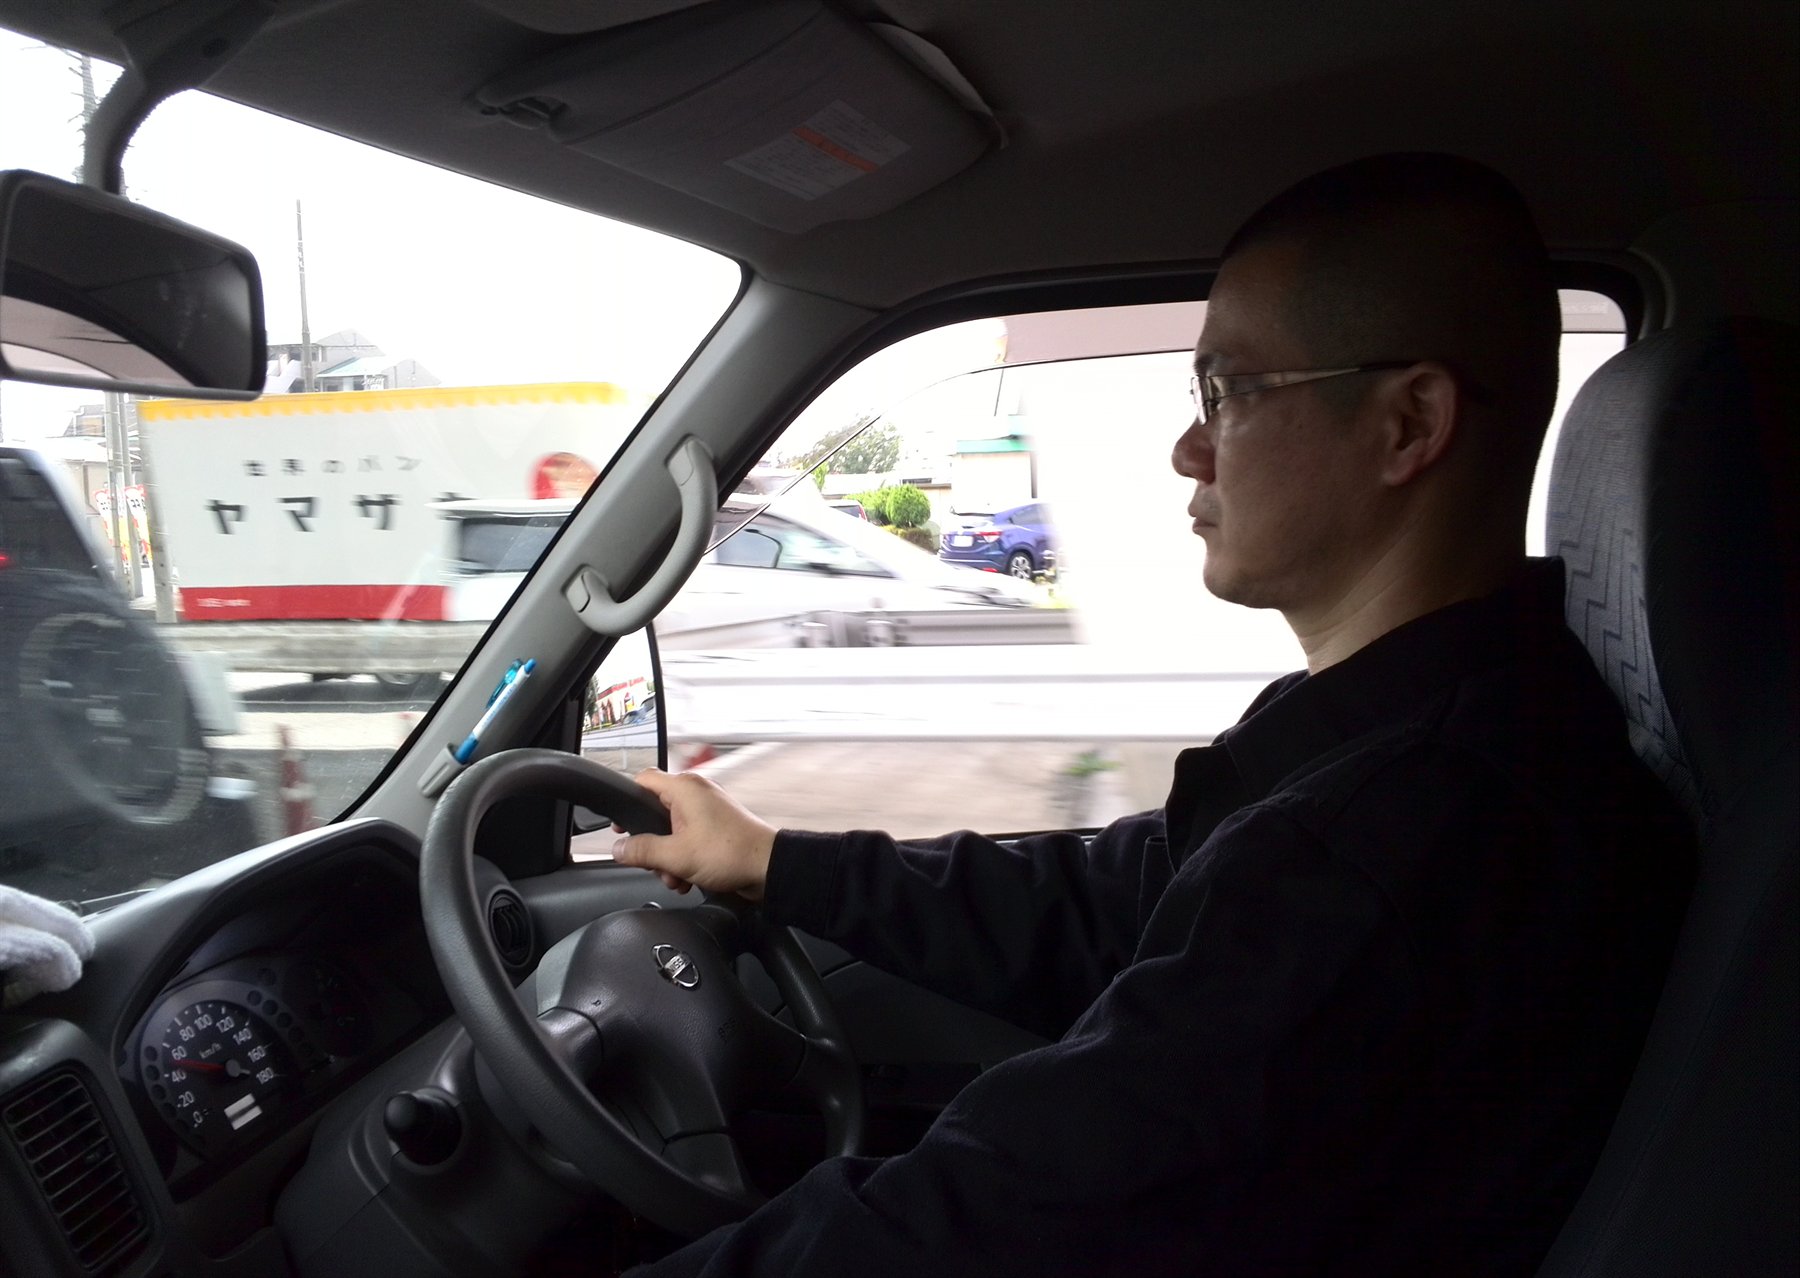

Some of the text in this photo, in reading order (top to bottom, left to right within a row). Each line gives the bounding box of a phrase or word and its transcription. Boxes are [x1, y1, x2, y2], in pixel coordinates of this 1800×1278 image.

[194, 1014, 212, 1031] 100
[216, 1016, 235, 1033] 120
[179, 1026, 195, 1041] 80
[233, 1027, 252, 1045] 140
[171, 1046, 187, 1061] 60
[199, 1042, 222, 1060] km/h
[247, 1045, 267, 1063] 160
[171, 1069, 187, 1083] 40
[256, 1067, 275, 1085] 180
[178, 1091, 194, 1108] 20
[193, 1111, 203, 1124] 0
